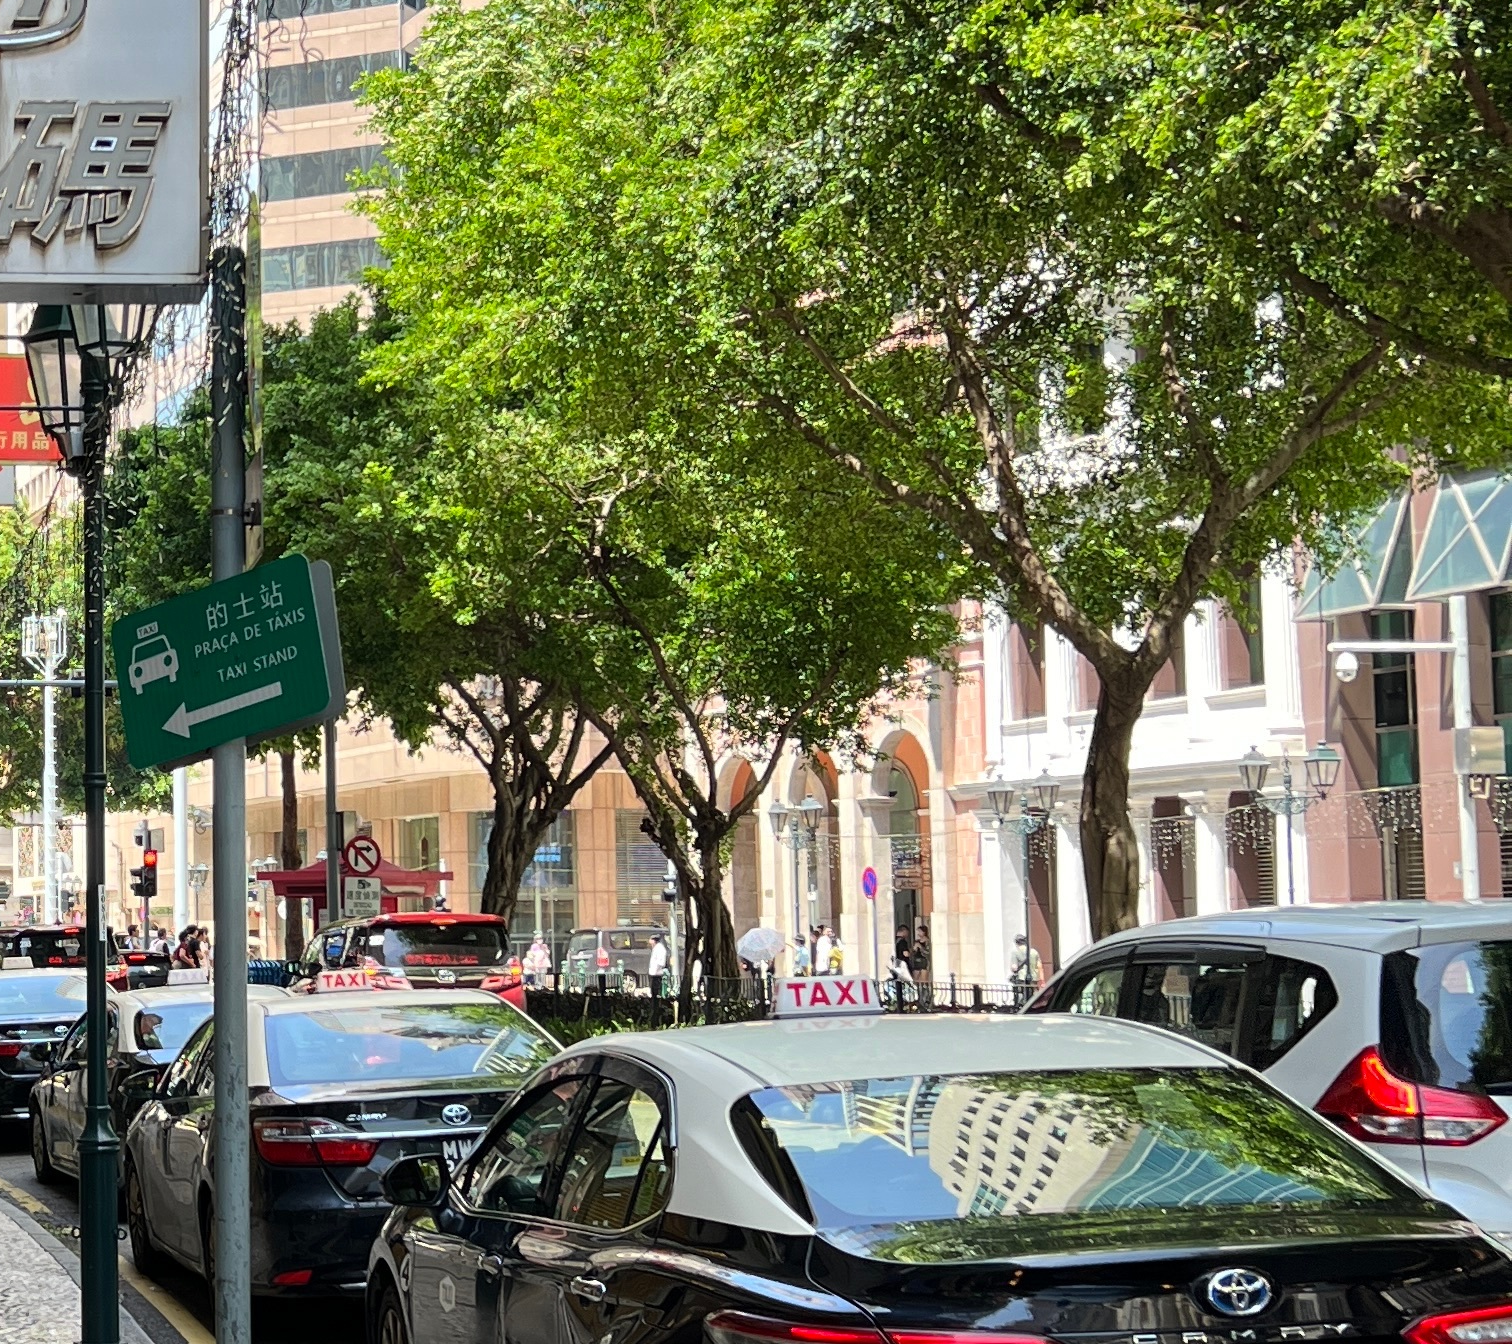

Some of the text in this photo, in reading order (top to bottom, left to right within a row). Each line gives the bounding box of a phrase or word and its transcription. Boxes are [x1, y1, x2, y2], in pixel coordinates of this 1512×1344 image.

[206, 580, 283, 631] 的士站
[138, 623, 157, 636] TAXI
[194, 607, 306, 658] PRAÇA DE TÁXIS
[217, 645, 298, 683] TAXI STAND
[322, 972, 367, 989] TAXI
[786, 979, 870, 1007] TAXI
[1133, 1323, 1351, 1344] CAMRY
